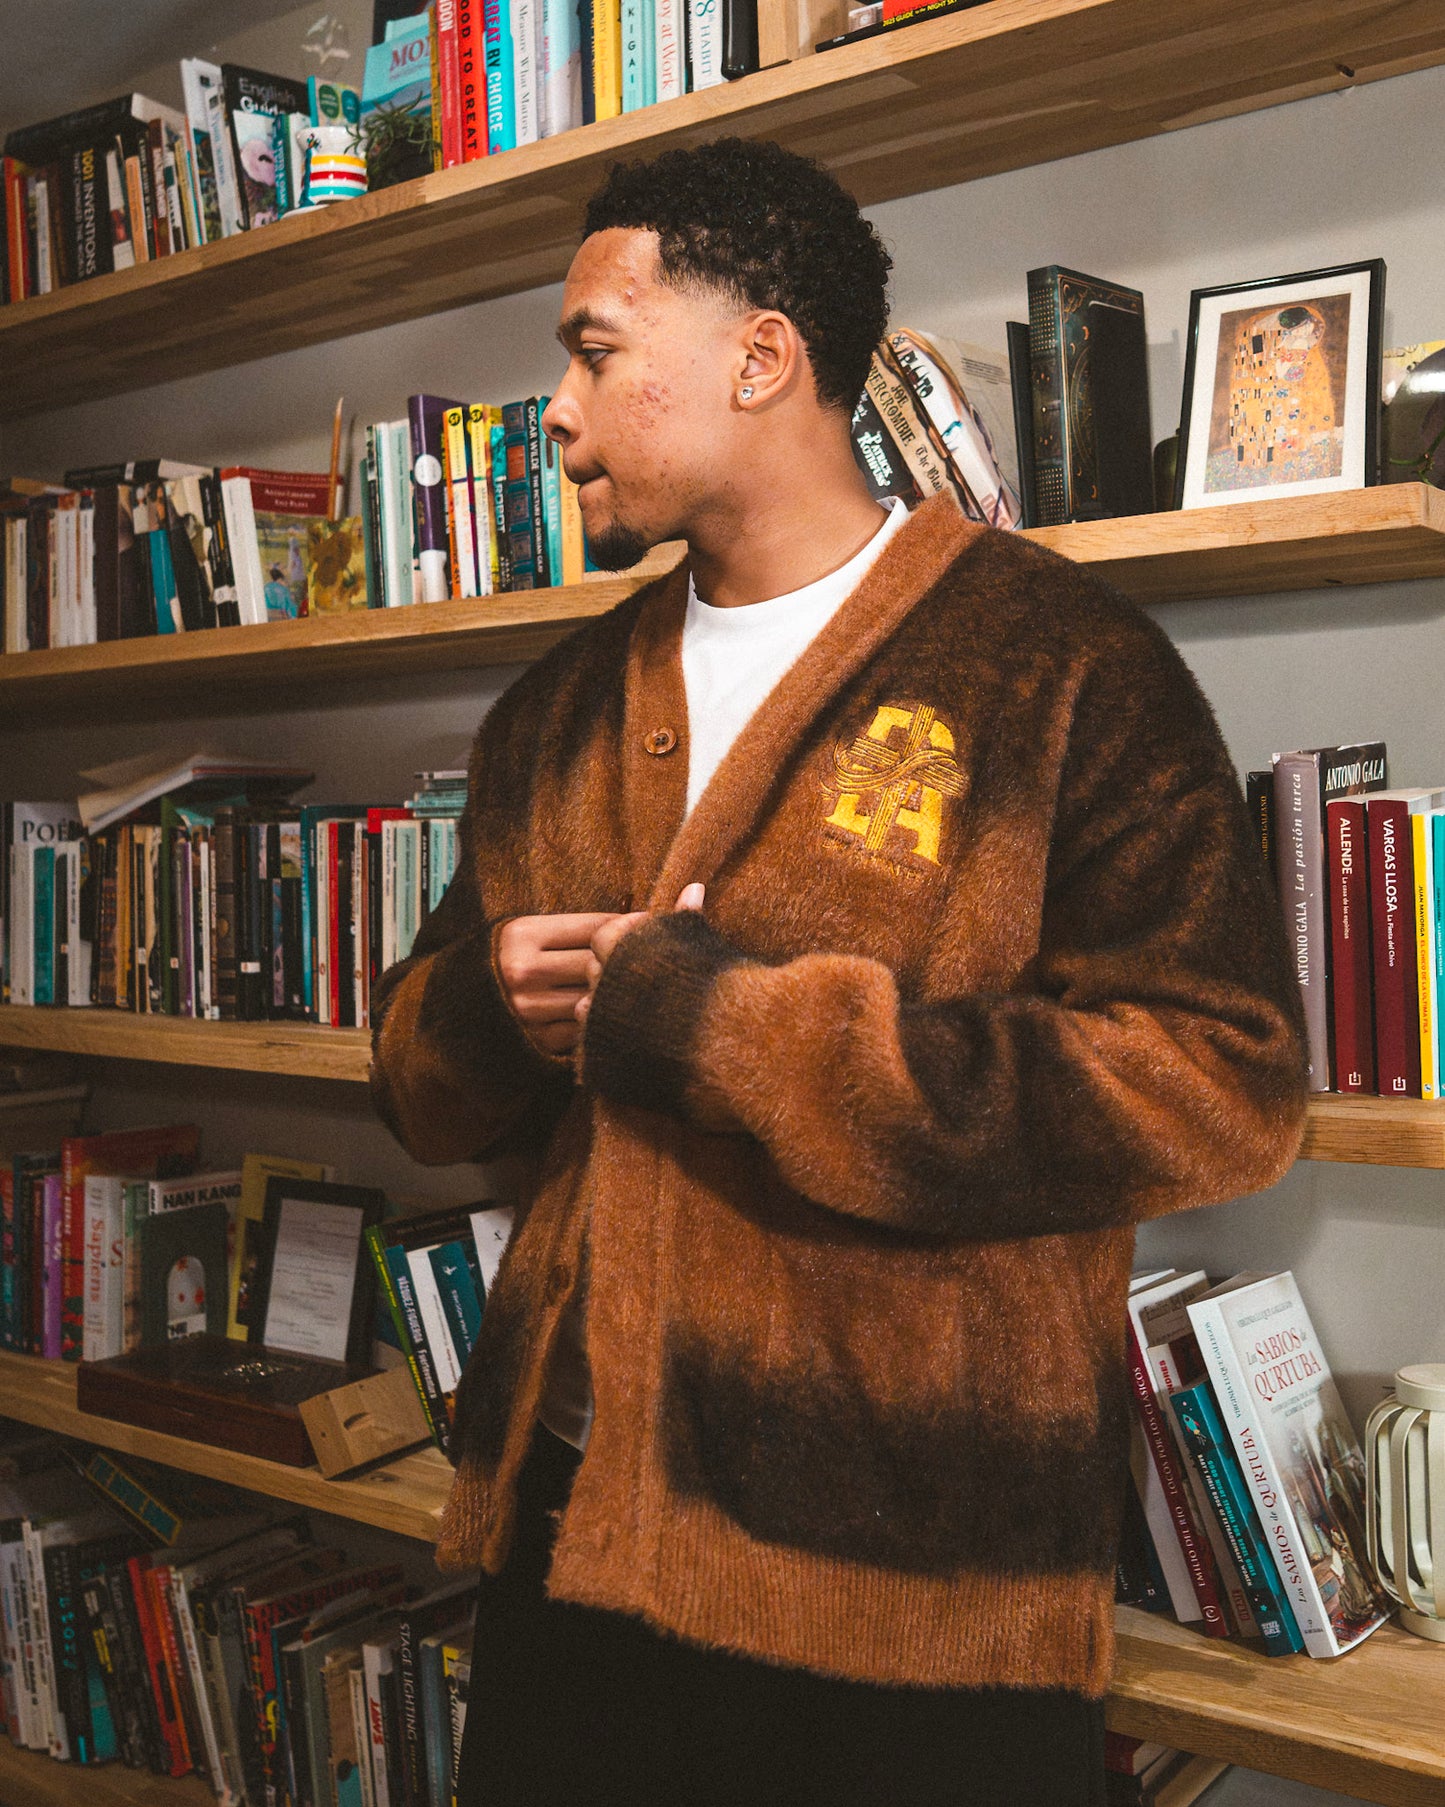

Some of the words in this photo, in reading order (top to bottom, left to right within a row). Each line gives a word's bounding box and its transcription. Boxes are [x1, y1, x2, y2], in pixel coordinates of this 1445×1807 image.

[520, 3, 529, 53] Measure
[662, 25, 673, 38] at
[895, 11, 915, 24] GUIDE
[462, 48, 473, 74] TO
[486, 48, 500, 68] BY
[522, 57, 530, 88] What
[661, 42, 675, 90] Work
[464, 83, 477, 147] GREAT
[488, 71, 504, 134] CHOICE
[522, 91, 531, 137] Matters
[84, 182, 97, 275] INVENTIONS
[890, 383, 909, 408] JOE
[527, 404, 537, 438] OSCAR
[529, 440, 539, 470] WILDE
[857, 431, 891, 487] ROTHFUSS
[870, 431, 893, 478] PATRICK
[532, 488, 540, 516] PICTURE
[547, 496, 561, 531] WELLS
[534, 526, 542, 554] DORIAN
[1292, 773, 1302, 811] turca
[1325, 762, 1361, 792] ANTONIO
[1362, 758, 1384, 783] GALA
[1292, 818, 1306, 867] pasión
[1339, 817, 1352, 874] ALLENDE
[1382, 818, 1396, 870] VARGAS
[1295, 872, 1305, 891] La
[1341, 876, 1348, 884] La
[1384, 871, 1397, 912] LLOSA
[1295, 901, 1307, 932] GALA
[1342, 897, 1348, 905] de
[1386, 914, 1393, 922] La
[1386, 922, 1394, 939] Fiesta
[1419, 939, 1425, 948] EL
[1297, 934, 1309, 985] ANTONIO
[1387, 949, 1395, 967] Chivo
[1420, 971, 1426, 980] DE
[1421, 981, 1427, 990] LA
[87, 1219, 105, 1302] Sapiens
[1204, 1321, 1222, 1359] GALLEGOS
[1254, 1327, 1303, 1364] SABIOS
[1254, 1350, 1322, 1401] QURTUBA
[1226, 1385, 1241, 1418] VIRGINIA
[1148, 1416, 1160, 1436] LOS
[1154, 1437, 1167, 1459] POR
[1161, 1460, 1178, 1495] LOCOS
[1240, 1427, 1276, 1508] QURTUBA
[1205, 1474, 1215, 1490] FIRST
[1211, 1490, 1222, 1507] BOOK
[1221, 1516, 1243, 1562] EXTRAORDINARY
[1240, 1564, 1252, 1586] WOMEN
[1268, 1510, 1279, 1522] de
[1181, 1528, 1194, 1547] DEL
[1274, 1524, 1301, 1584] SABIOS
[1187, 1549, 1206, 1587] EMILIO
[1296, 1586, 1307, 1603] Los
[399, 1622, 412, 1664] STAGE
[402, 1671, 416, 1739] LIGHTING
